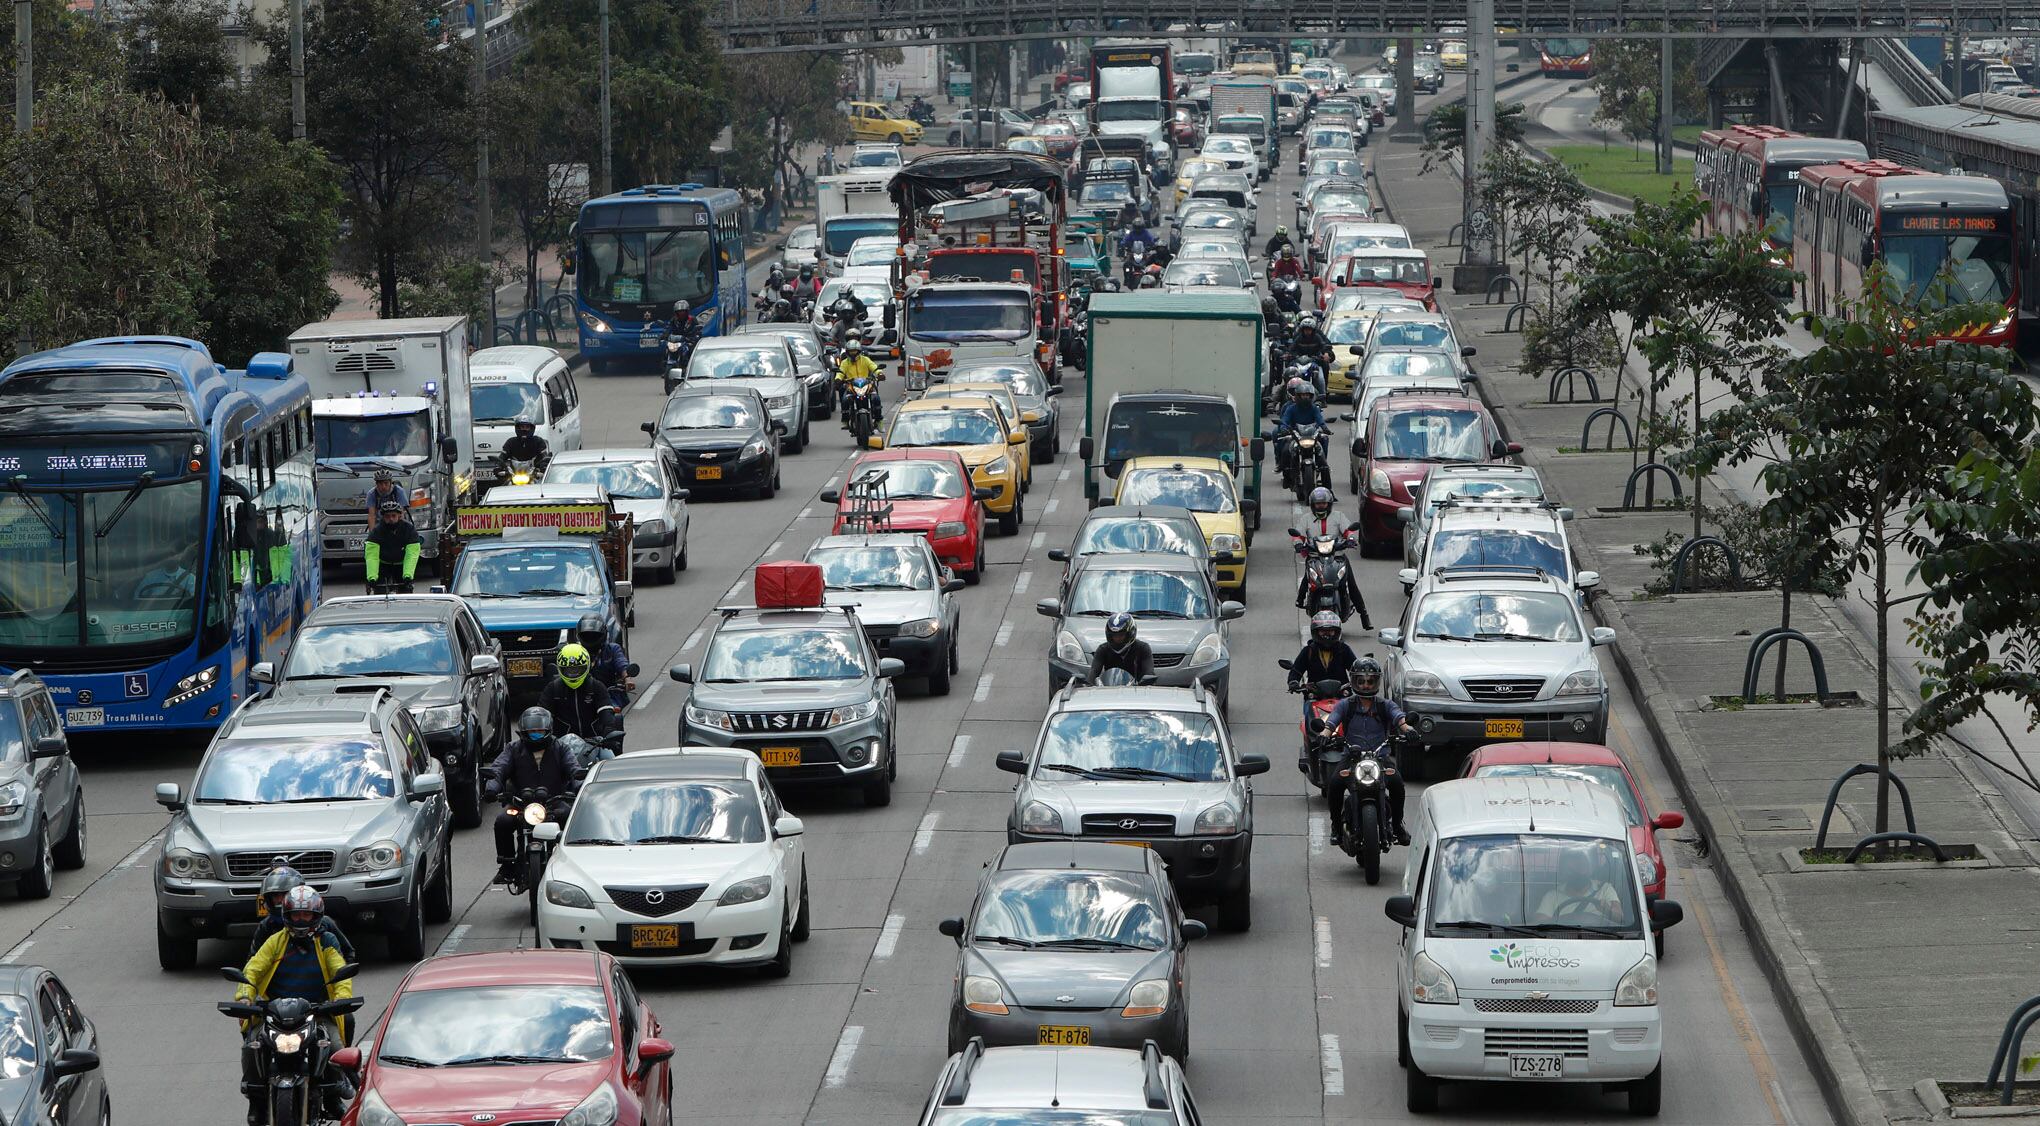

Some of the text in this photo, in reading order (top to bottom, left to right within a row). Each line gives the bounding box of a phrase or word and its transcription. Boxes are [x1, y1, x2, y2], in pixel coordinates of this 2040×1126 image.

[1903, 217, 1996, 230] LAVATE LAS MANOS
[494, 514, 499, 529] Y
[501, 513, 530, 529] LARGA
[531, 512, 562, 528] CARGA
[112, 621, 177, 633] BUSSCAR
[106, 713, 164, 722] TransMilenio
[1491, 976, 1538, 985] Comprometidos
